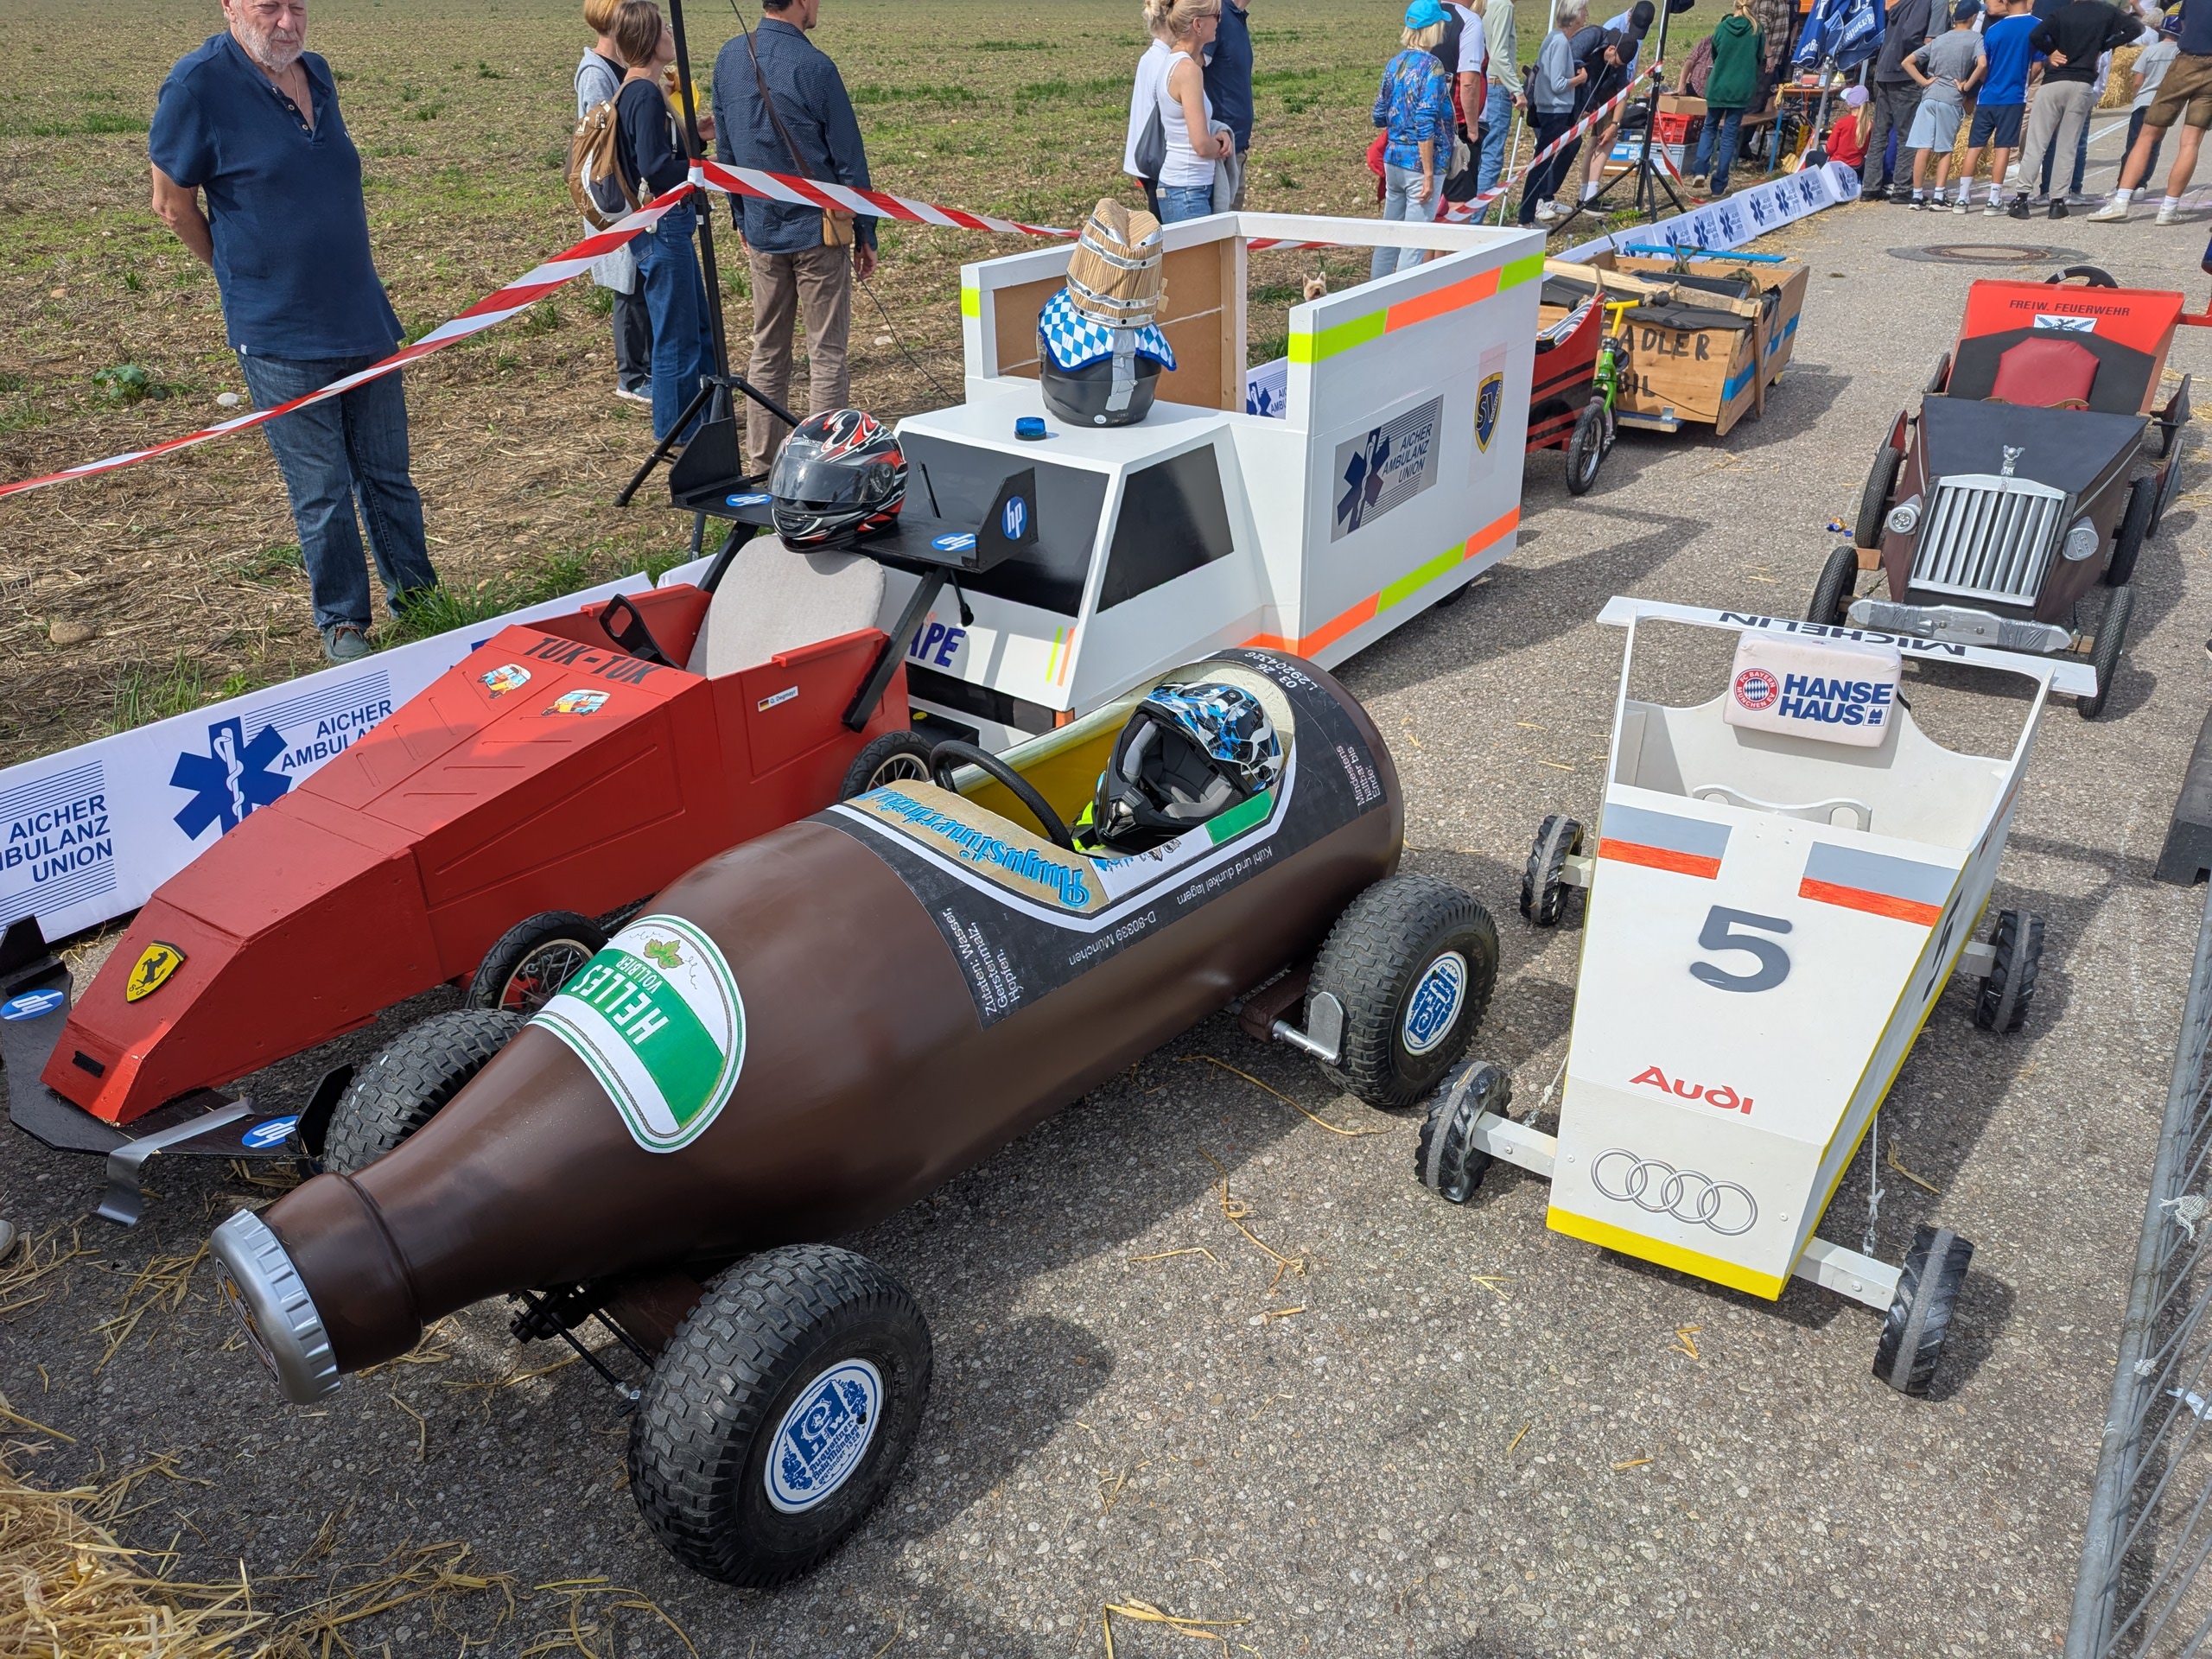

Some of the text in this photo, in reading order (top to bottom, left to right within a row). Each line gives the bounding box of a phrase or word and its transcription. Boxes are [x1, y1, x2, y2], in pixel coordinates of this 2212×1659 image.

[2010, 300, 2130, 316] FREIW. FEUERWEHR
[1382, 439, 1429, 477] AMBULANZ
[1400, 423, 1433, 452] AICHER
[1398, 456, 1426, 483] UNION
[1006, 500, 1023, 539] hp
[1719, 612, 1967, 657] MICHELIN
[523, 637, 664, 684] TUK-TUK
[1739, 671, 1777, 689] FC BAYERN
[1778, 696, 1866, 726] HAUS
[1783, 673, 1894, 705] HANSE
[316, 699, 393, 740] AICHER
[1336, 746, 1365, 806] Mindestens
[1347, 747, 1373, 802] haltbar bis
[1365, 765, 1381, 798] Ende:
[9, 794, 107, 844] AICHER
[32, 838, 113, 882] UNION
[1176, 845, 1273, 905] Kühl und dunkel lagern
[1068, 911, 1157, 966] D-80339 München
[1689, 904, 1793, 993] 5
[615, 955, 664, 995] VOLLBIER
[942, 907, 998, 1016] Zutaten: Wasser,
[968, 922, 1008, 1008] Gerstenmalz,
[996, 949, 1020, 1003] Hopfen.
[3, 991, 64, 1020] hp
[570, 963, 670, 1046] HELLES
